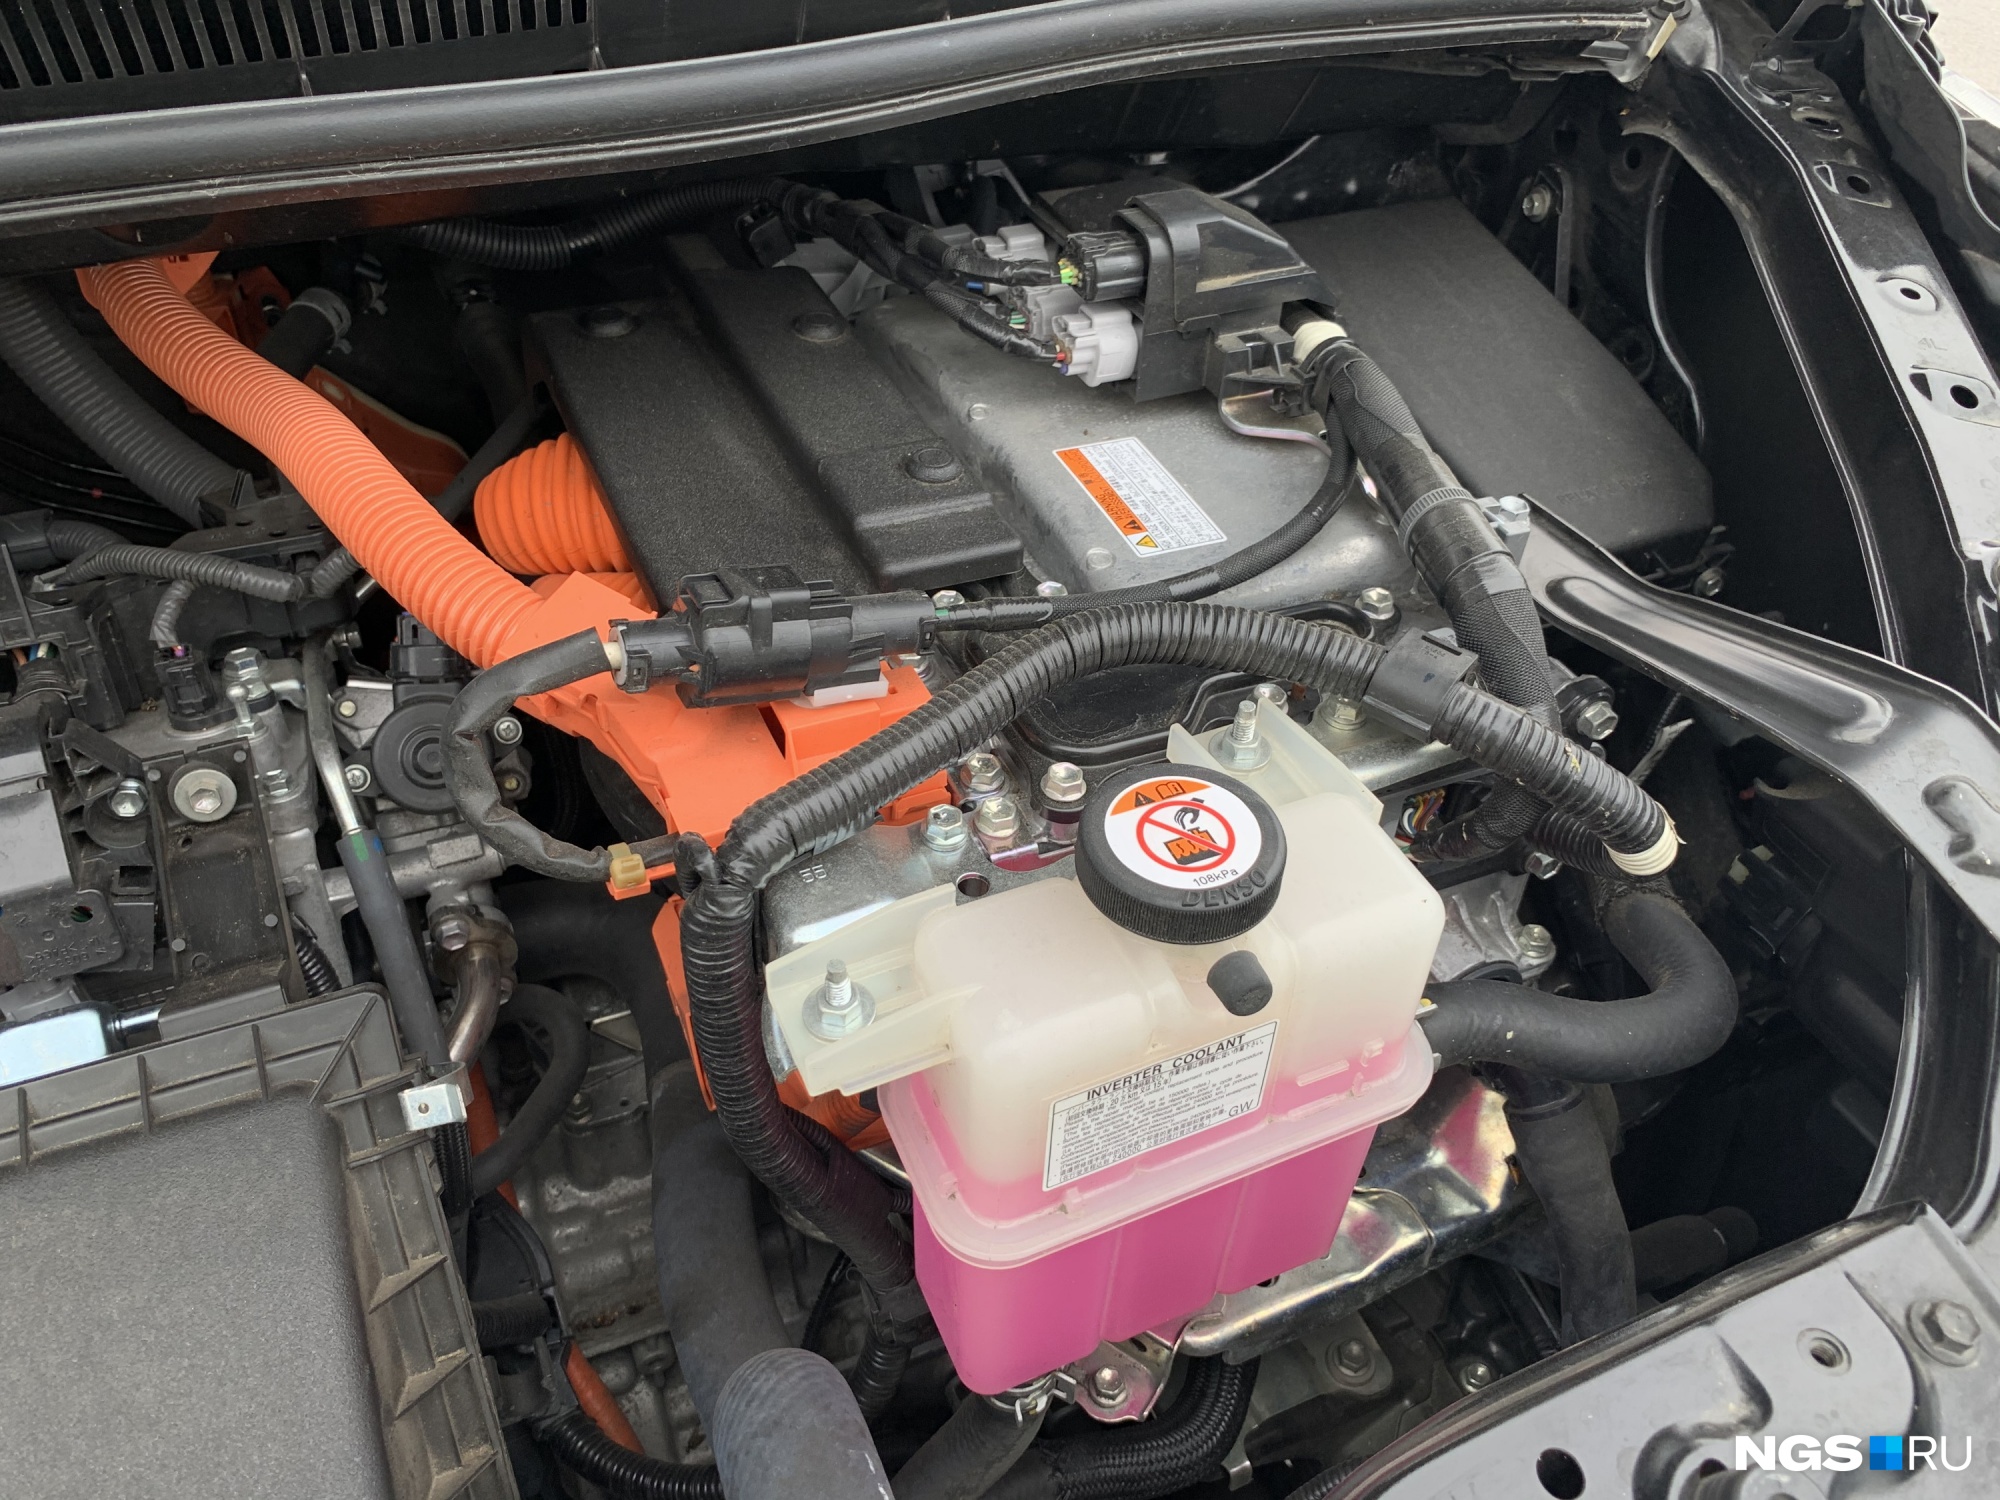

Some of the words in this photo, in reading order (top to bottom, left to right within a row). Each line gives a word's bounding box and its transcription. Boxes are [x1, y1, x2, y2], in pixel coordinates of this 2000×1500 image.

[1093, 493, 1125, 522] WARNING
[798, 863, 828, 884] 55
[1192, 868, 1239, 887] 108kPa
[1181, 868, 1268, 909] DENSO
[1086, 1063, 1163, 1100] INVERTER
[1172, 1034, 1247, 1068] COOLANT
[1109, 1096, 1119, 1105] 20
[1127, 1089, 1138, 1098] km
[1153, 1080, 1162, 1089] 15
[1228, 1099, 1255, 1118] GW
